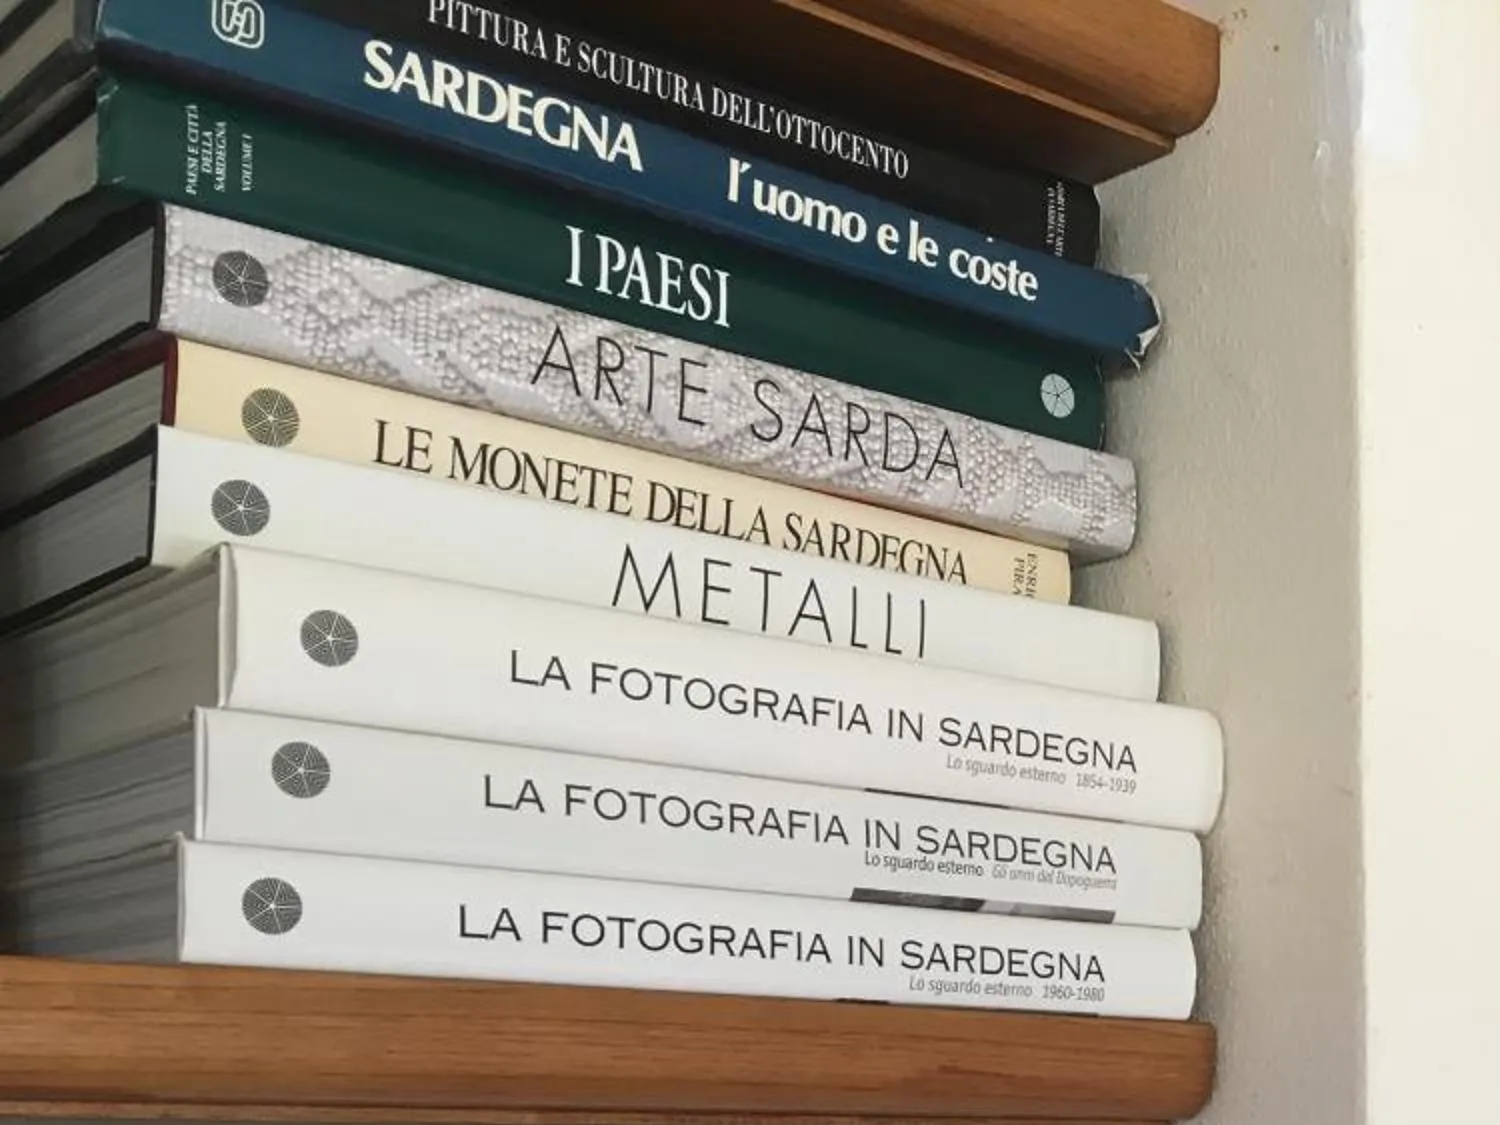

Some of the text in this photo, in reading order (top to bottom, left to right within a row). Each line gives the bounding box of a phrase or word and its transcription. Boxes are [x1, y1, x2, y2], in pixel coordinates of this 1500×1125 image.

[427, 0, 910, 180] PITTURA E SCULTURA DELL'OTTOCENTO
[185, 157, 199, 195] PAESI
[187, 144, 199, 155] E
[201, 130, 213, 174] DELLA
[213, 121, 227, 192] SARDEGNA
[241, 140, 253, 191] VOLUME
[363, 39, 1039, 302] SARDEGNA l'uomo e le coste
[565, 225, 732, 328] I PAESI
[530, 325, 964, 489] ARTE SARDA
[373, 418, 969, 586] LE MONETE DELLA SARDEGNA
[610, 542, 927, 660] METALLI
[510, 649, 1139, 773] LA FOTOGRAFIA IN SARDEGNA
[946, 754, 1138, 796] Lo sguardo esterno 1854-1939
[483, 774, 1118, 875] LA FOTOGRAFIA IN SARDEGNA
[864, 851, 879, 867] Lo
[883, 855, 934, 878] sguardo
[937, 861, 984, 878] esterno
[458, 904, 1106, 984] LA FOTOGRAFIA IN SARDEGNA
[909, 976, 1106, 1004] Lo sguardo esterno 1960-1980
